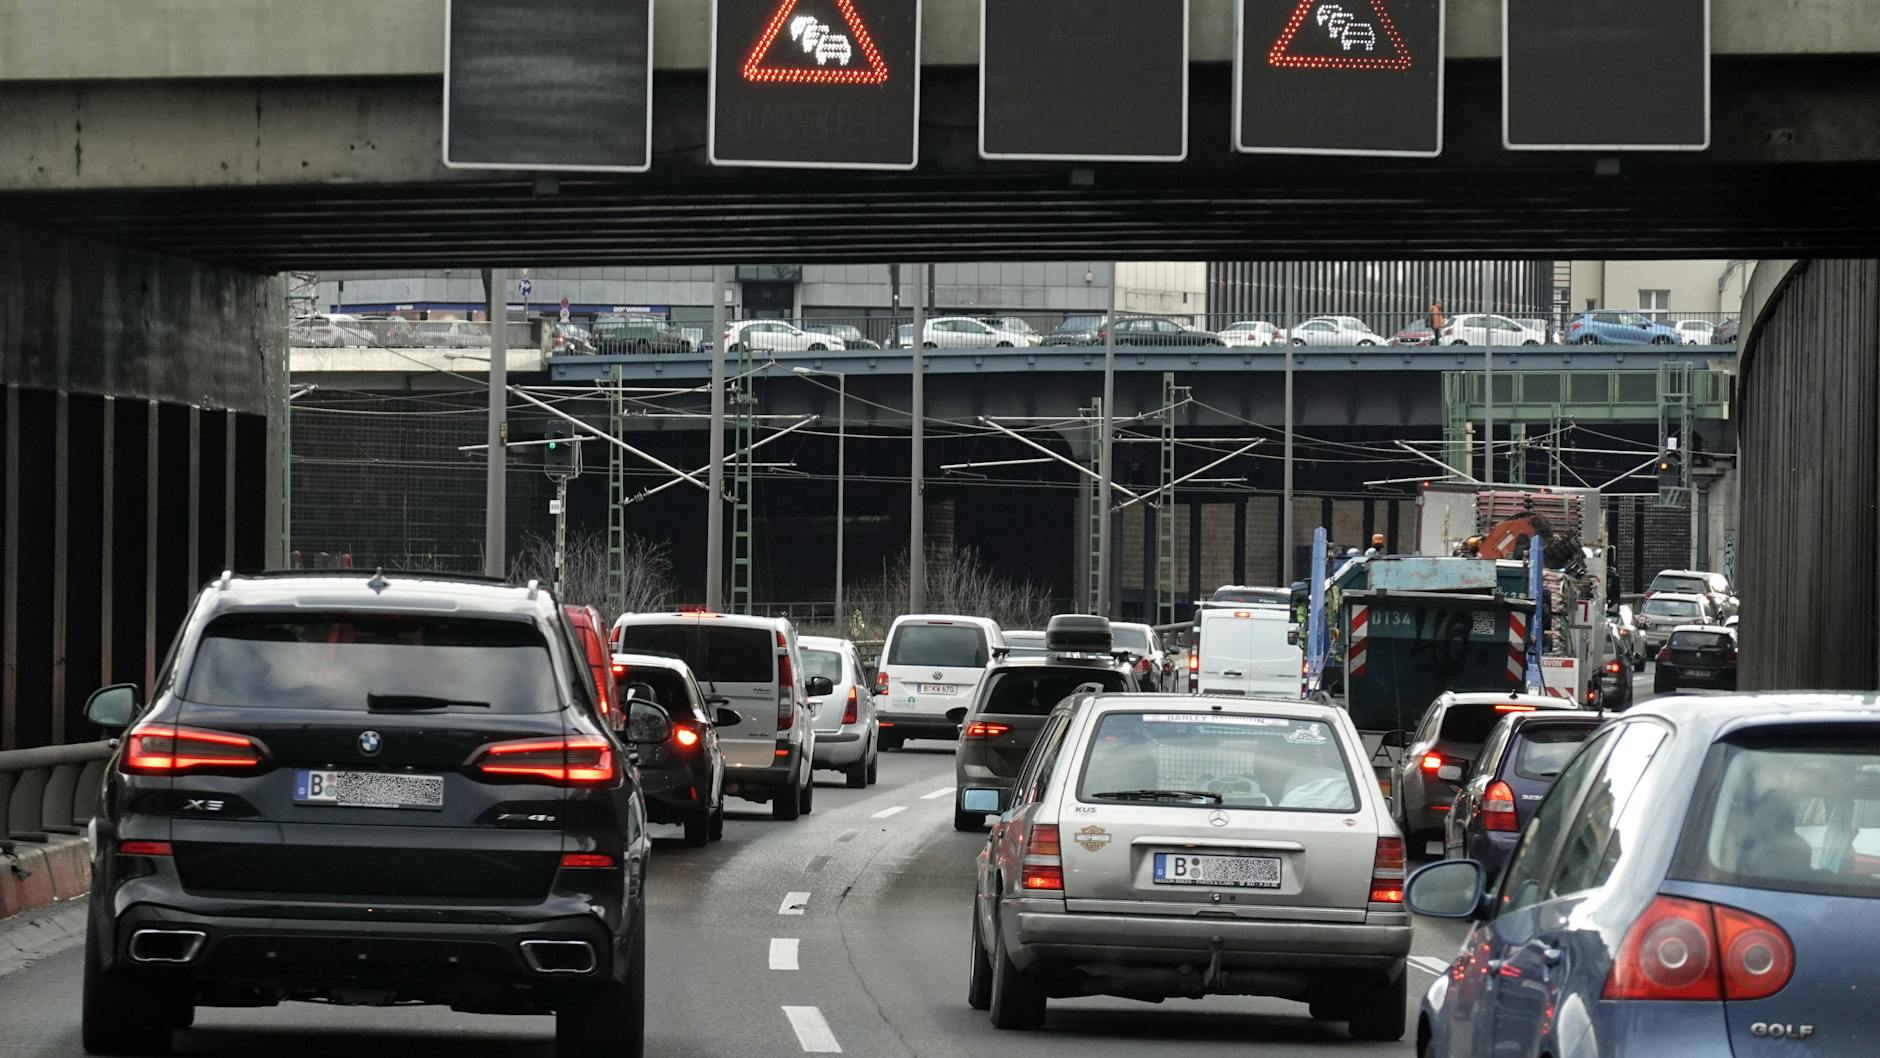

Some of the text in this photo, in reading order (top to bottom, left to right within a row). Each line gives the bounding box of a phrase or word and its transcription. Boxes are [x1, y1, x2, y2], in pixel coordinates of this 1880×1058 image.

[1371, 611, 1411, 626] D134
[1372, 742, 1392, 761] A
[311, 774, 323, 796] B
[1175, 857, 1187, 876] B
[1750, 1022, 1814, 1038] GOLF
